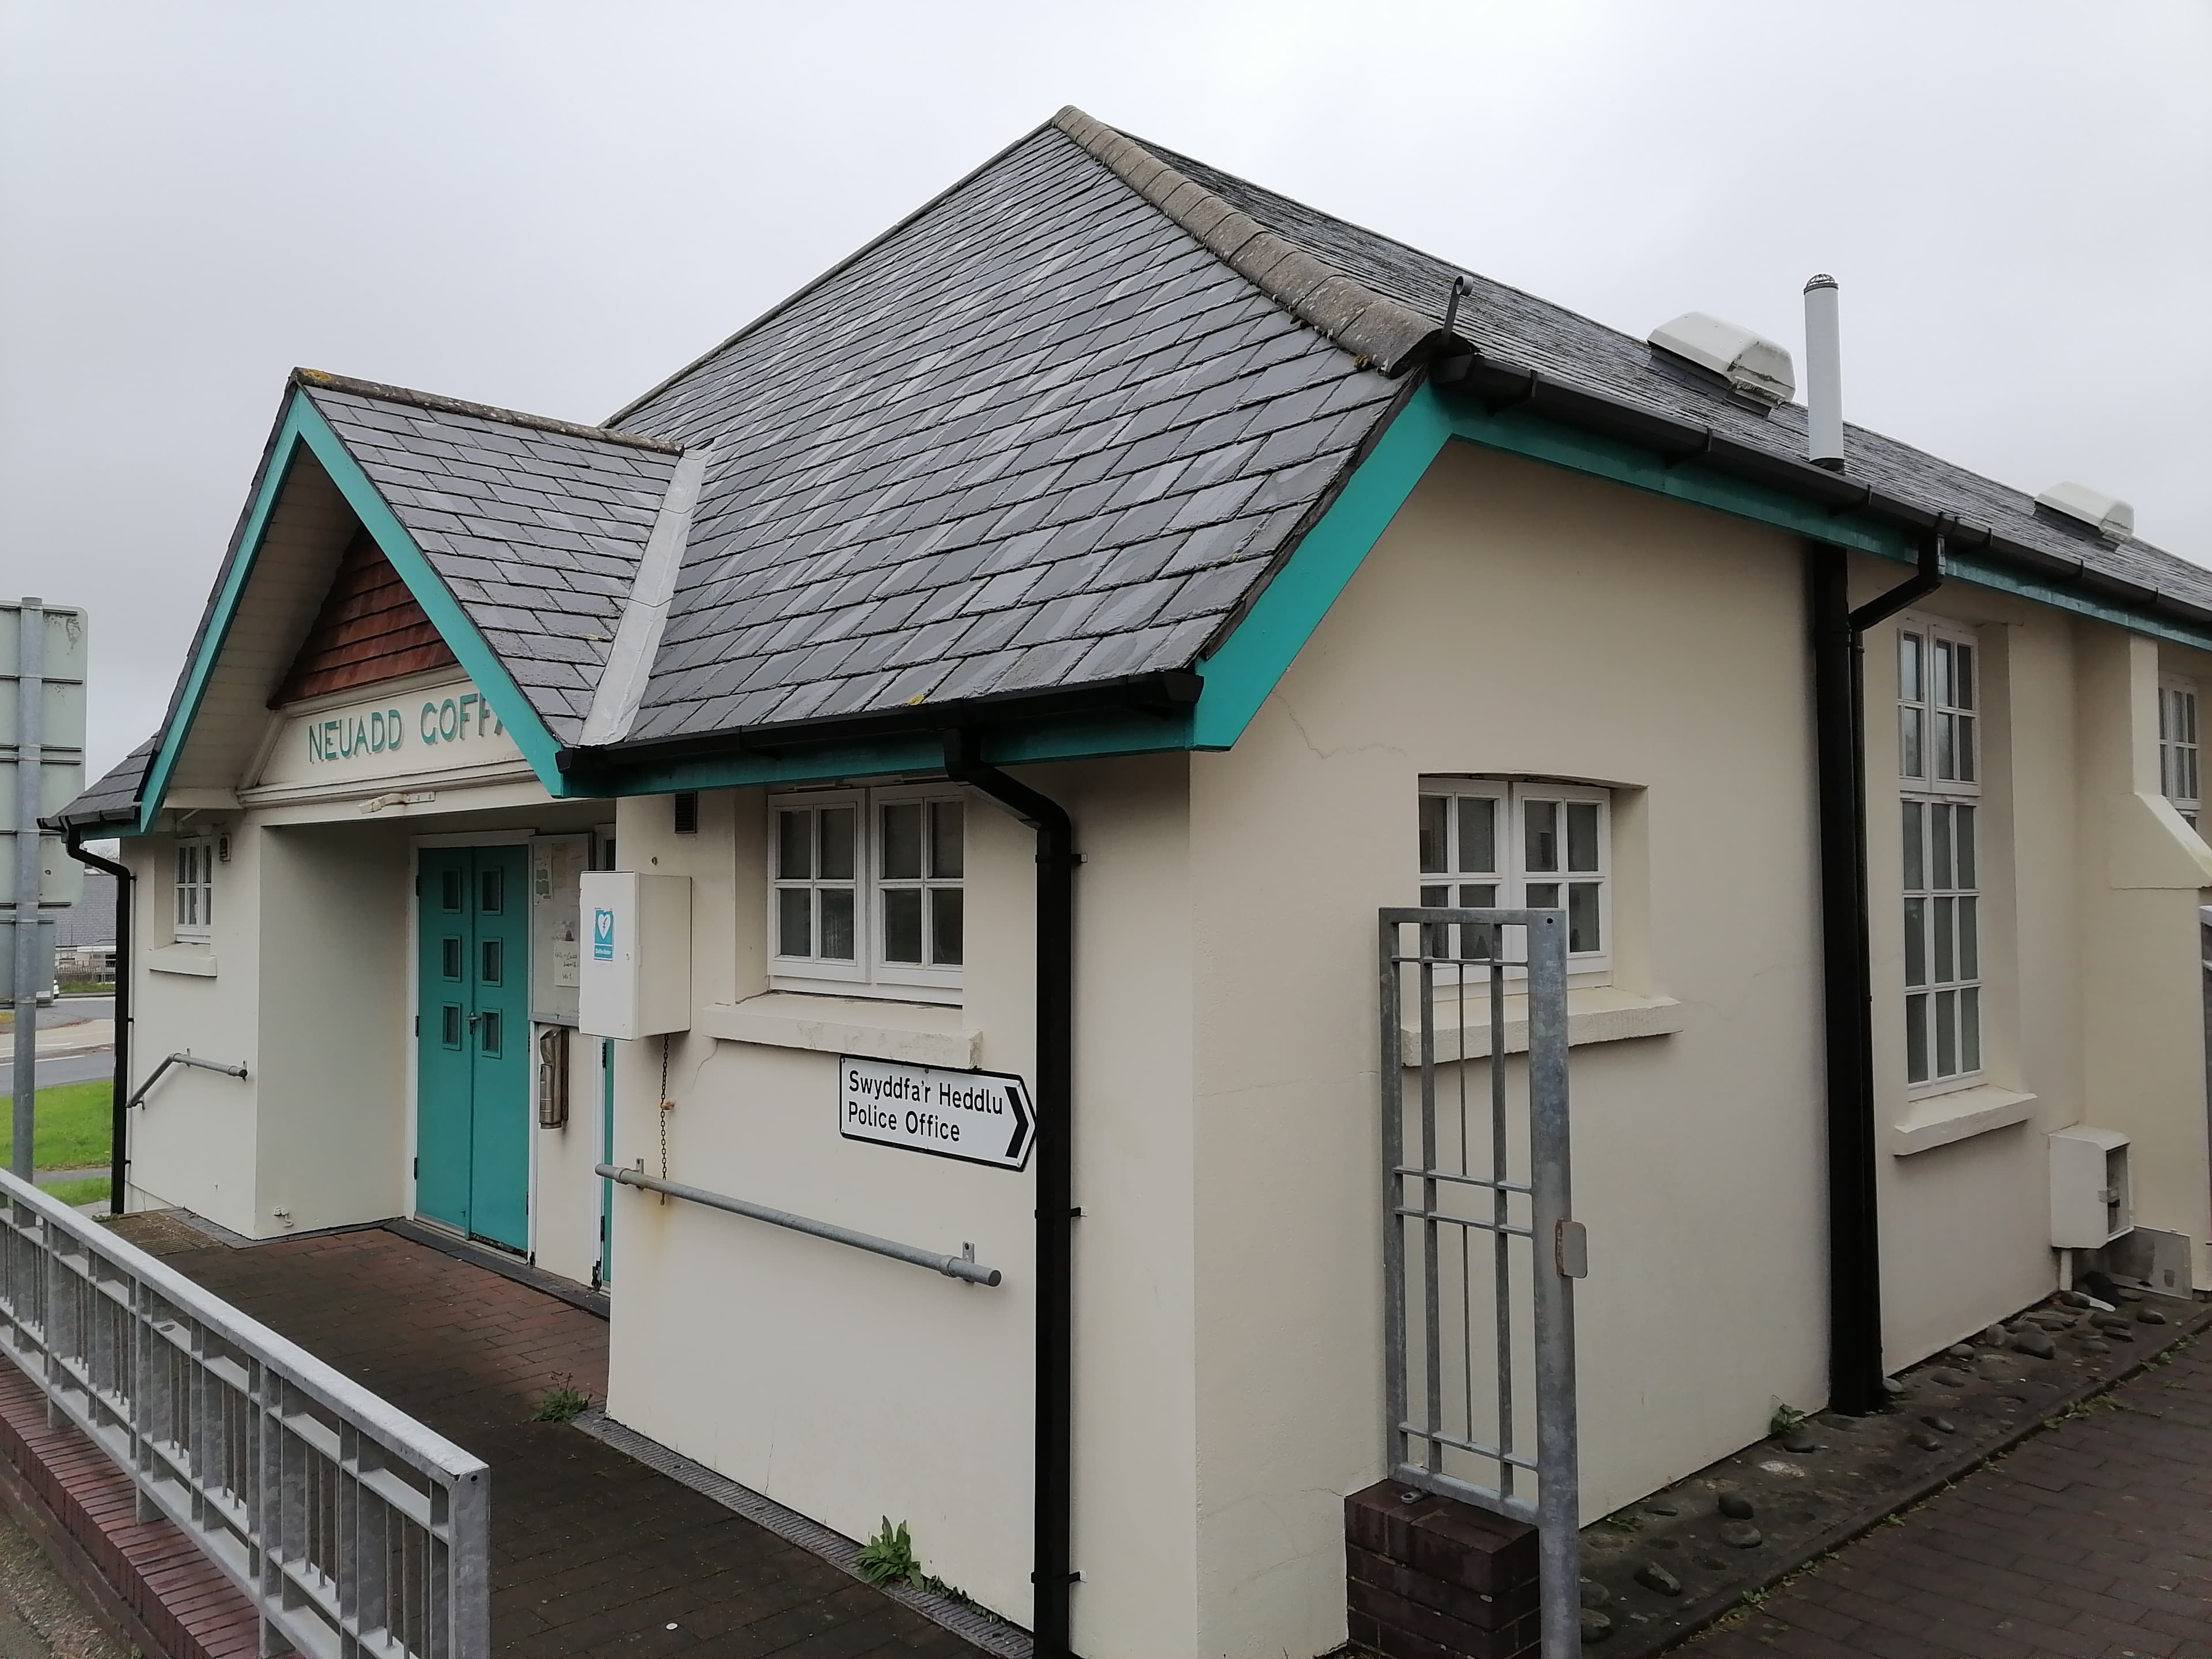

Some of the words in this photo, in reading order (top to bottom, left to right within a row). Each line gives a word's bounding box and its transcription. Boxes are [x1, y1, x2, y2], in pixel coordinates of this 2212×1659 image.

[309, 709, 402, 763] NEUADD
[421, 692, 503, 745] GOFF
[849, 1070, 931, 1103] Swyddfa'r
[940, 1082, 1003, 1115] Heddlu
[849, 1101, 897, 1130] Police
[905, 1111, 960, 1142] Office
